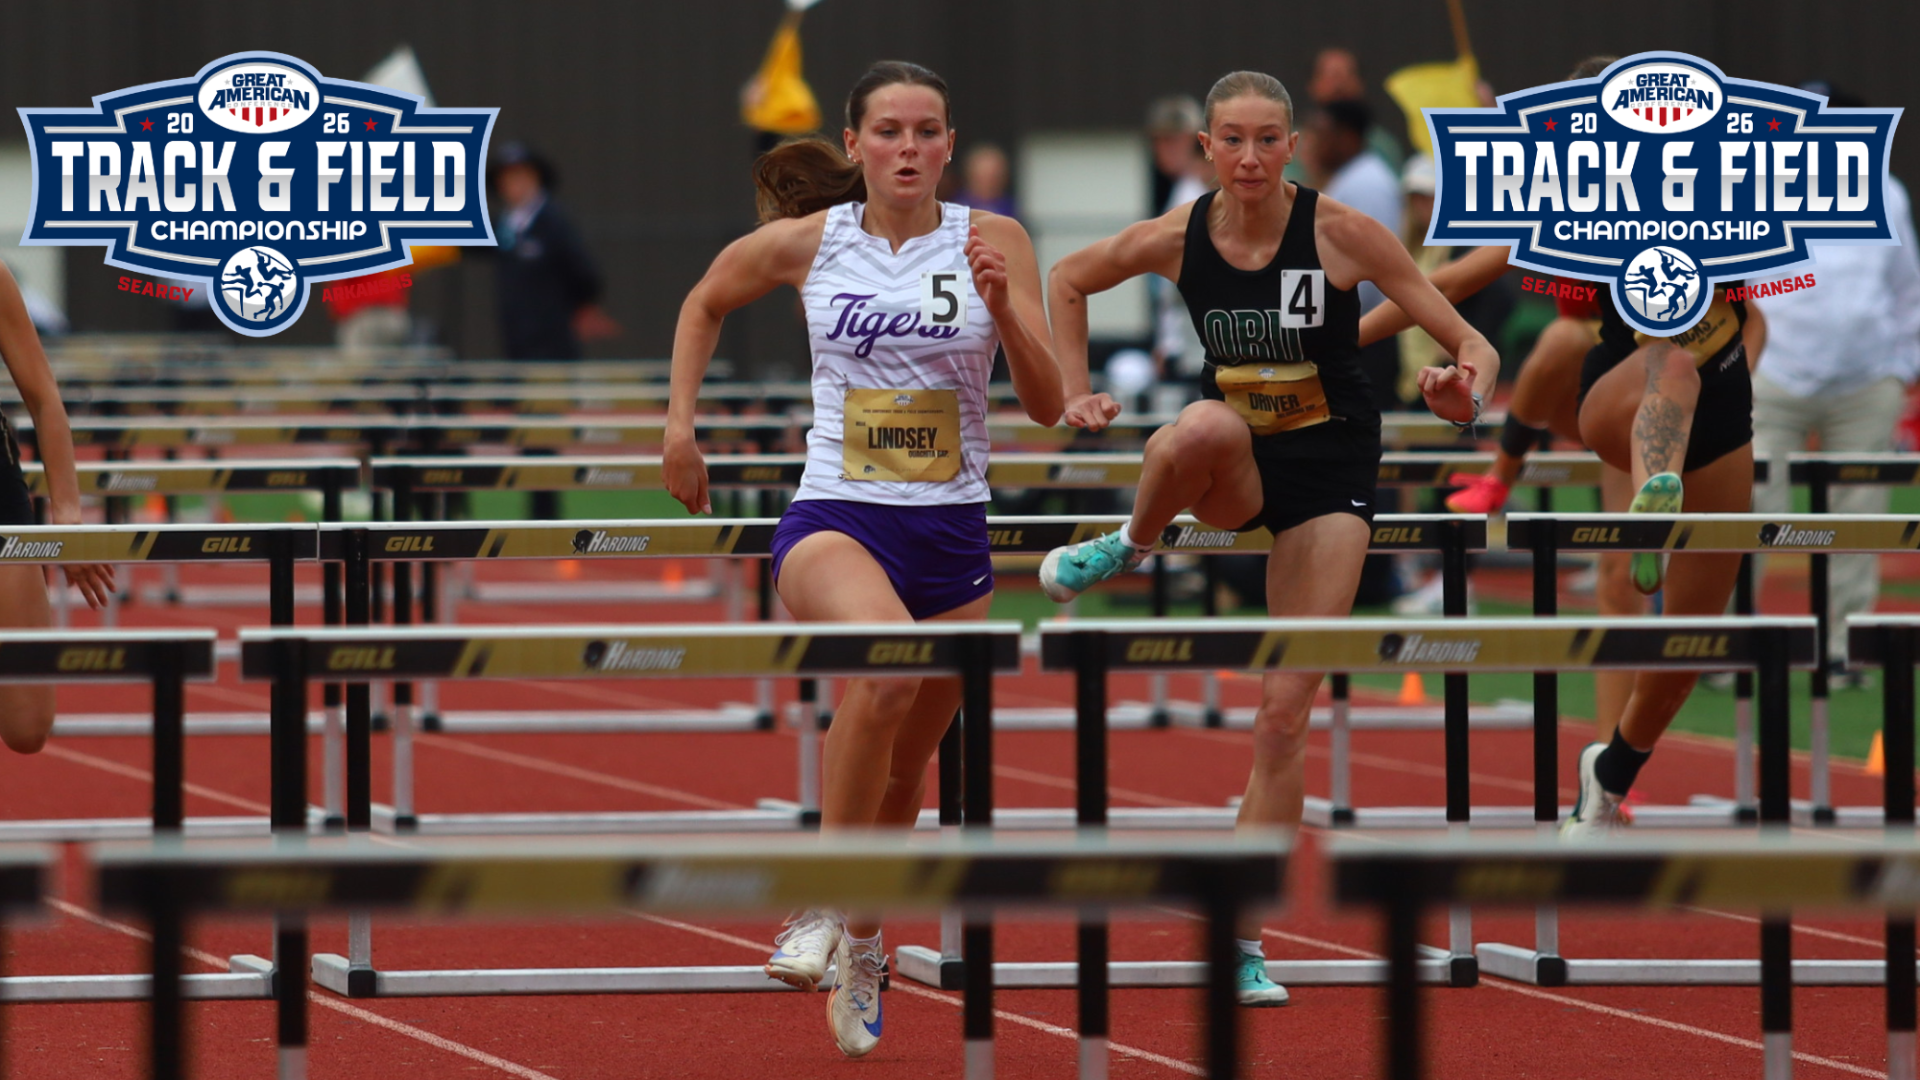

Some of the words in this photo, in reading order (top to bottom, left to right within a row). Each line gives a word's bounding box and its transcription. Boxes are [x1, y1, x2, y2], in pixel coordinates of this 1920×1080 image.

[932, 274, 959, 324] 5
[1288, 274, 1317, 325] 4
[826, 292, 960, 359] Tige
[1248, 392, 1300, 412] DRIVER
[868, 427, 938, 449] LINDSEY
[201, 537, 252, 553] GILL
[384, 536, 434, 552] GILL
[587, 530, 650, 553] HARDING
[1175, 526, 1238, 548] HARDING
[1373, 527, 1423, 543] GILL
[1571, 526, 1621, 543] GILL
[1773, 524, 1836, 546] HARDING
[0, 536, 63, 558] HARDING
[599, 640, 686, 670] HARDING
[867, 641, 936, 664] GILL
[1126, 638, 1194, 662] GILL
[1395, 634, 1482, 663] HARDING
[1661, 635, 1729, 658] GILL
[57, 648, 126, 670] GILL
[328, 647, 398, 670] GILL
